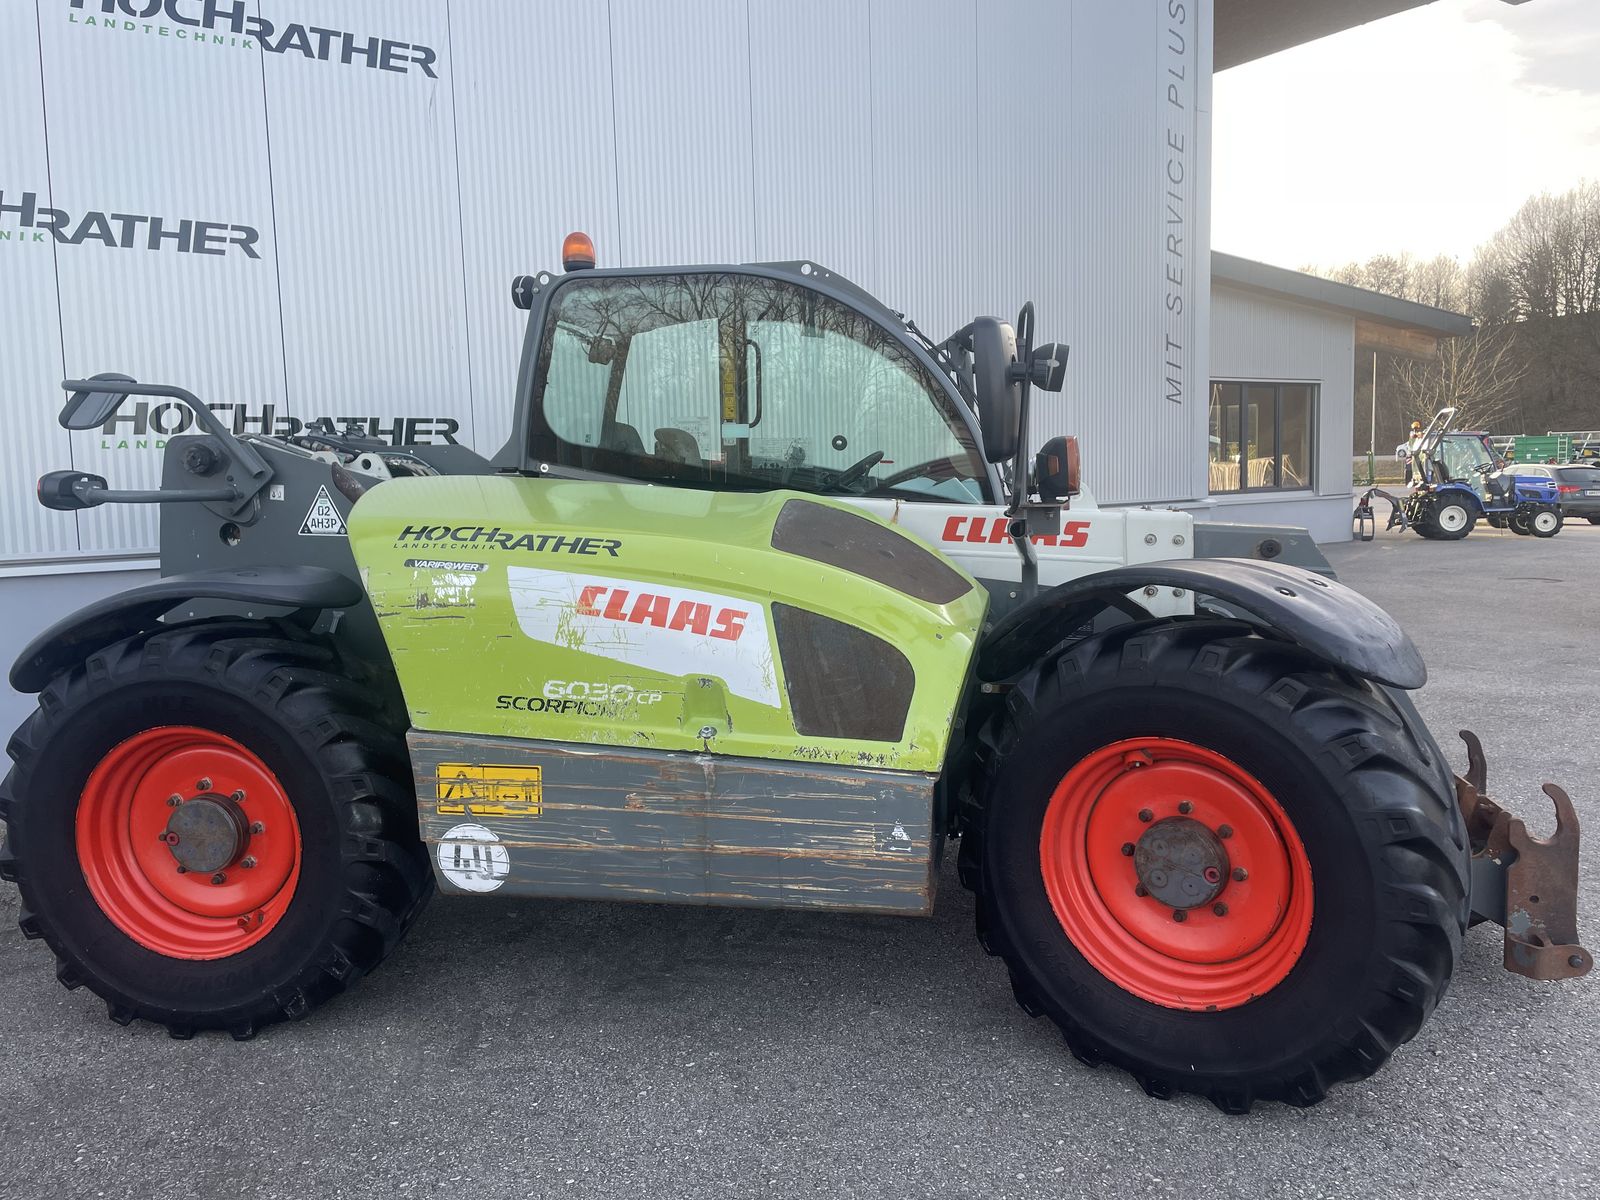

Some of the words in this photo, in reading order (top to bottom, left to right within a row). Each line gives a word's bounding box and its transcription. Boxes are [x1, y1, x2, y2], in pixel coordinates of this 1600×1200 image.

[69, 13, 254, 50] LANDTECHNIK
[1168, 0, 1186, 110] PLUS
[1166, 129, 1186, 316] SERVICE
[1166, 334, 1183, 405] MIT
[310, 518, 337, 529] AH3P
[397, 525, 623, 557] HOCHRATHER
[414, 560, 479, 571] VARIPOWER
[576, 586, 749, 641] CLAAS
